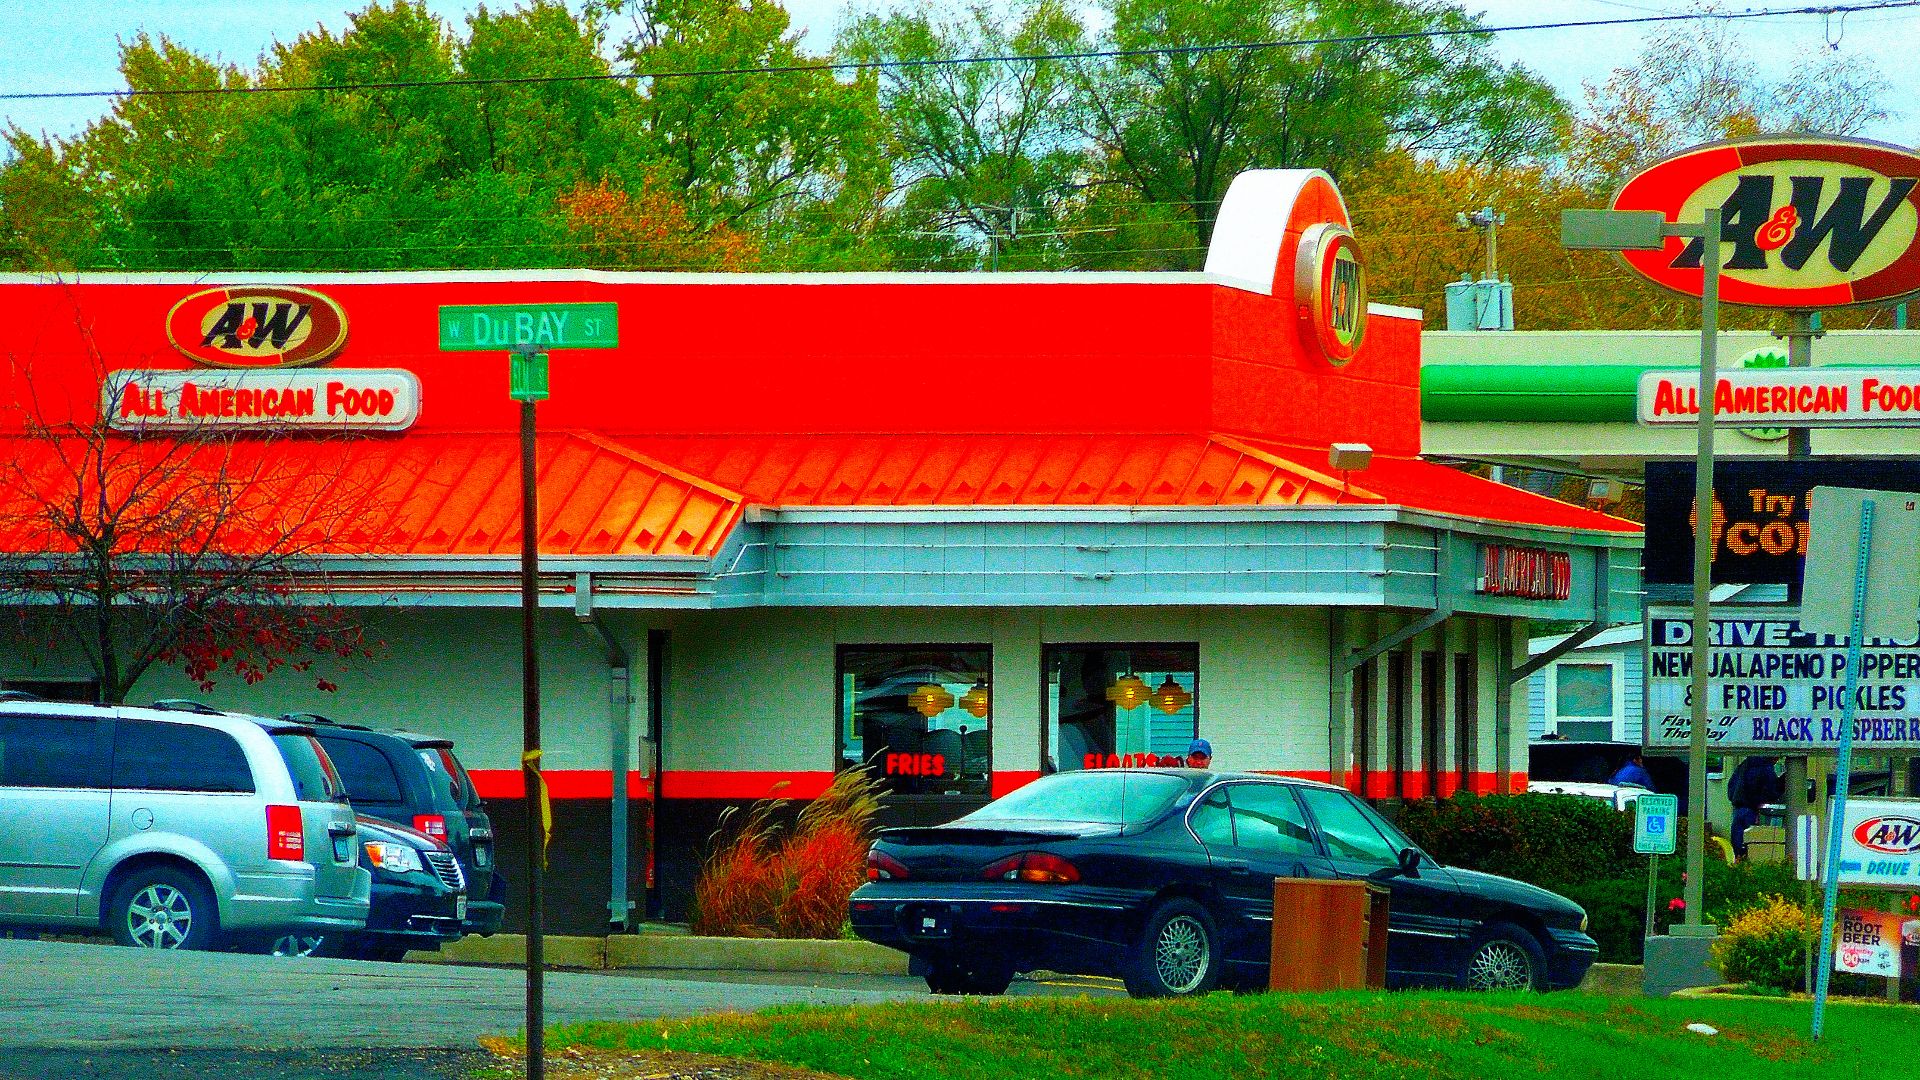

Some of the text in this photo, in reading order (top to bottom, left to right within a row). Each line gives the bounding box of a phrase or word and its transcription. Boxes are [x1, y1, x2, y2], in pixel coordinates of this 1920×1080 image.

[1668, 175, 1919, 272] A&W
[201, 303, 312, 349] A&W
[449, 320, 461, 338] W
[584, 319, 603, 337] ST
[120, 381, 394, 418] ALL AMERICAN FOOD
[1653, 379, 1699, 416] ALL
[1713, 378, 1848, 416] AMERICAN
[1747, 488, 1796, 518] Try
[1707, 652, 1825, 679] JALAPENO
[1830, 653, 1920, 679] PPPER
[1723, 685, 1787, 710] FRIED
[1812, 685, 1906, 711] PICKLES
[1719, 715, 1738, 727] Of
[1752, 717, 1813, 741] BLACK
[887, 752, 945, 777] FRIES
[1868, 824, 1920, 846] A&W
[1867, 860, 1910, 875] DRIVE
[1842, 932, 1881, 946] BEER
[1843, 919, 1882, 935] ROOT
